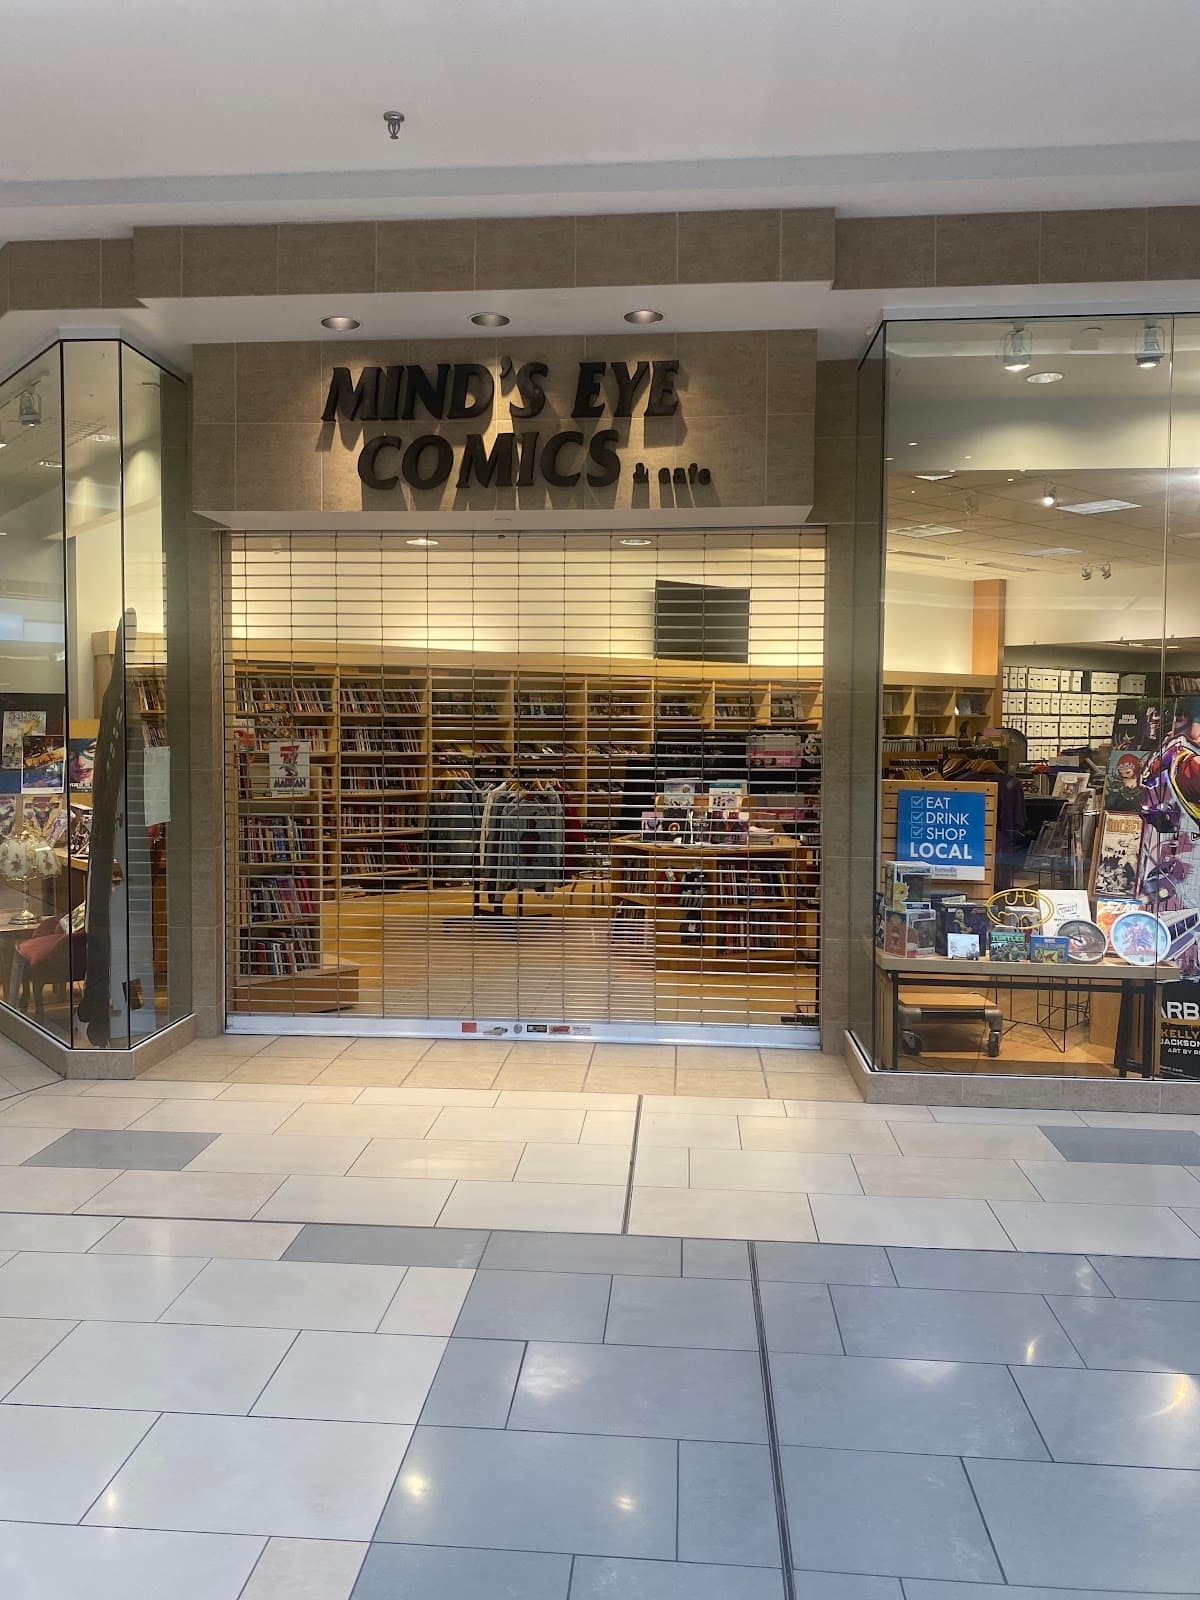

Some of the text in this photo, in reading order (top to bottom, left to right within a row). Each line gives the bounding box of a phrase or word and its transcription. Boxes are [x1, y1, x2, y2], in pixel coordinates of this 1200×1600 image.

[321, 355, 680, 422] MIND'S EYE
[357, 429, 621, 490] COMICS
[926, 796, 951, 809] EAT
[926, 811, 970, 825] DRINK
[926, 827, 967, 840] SHOP
[910, 842, 972, 859] LOCAL
[1160, 1028, 1199, 1040] KELLY
